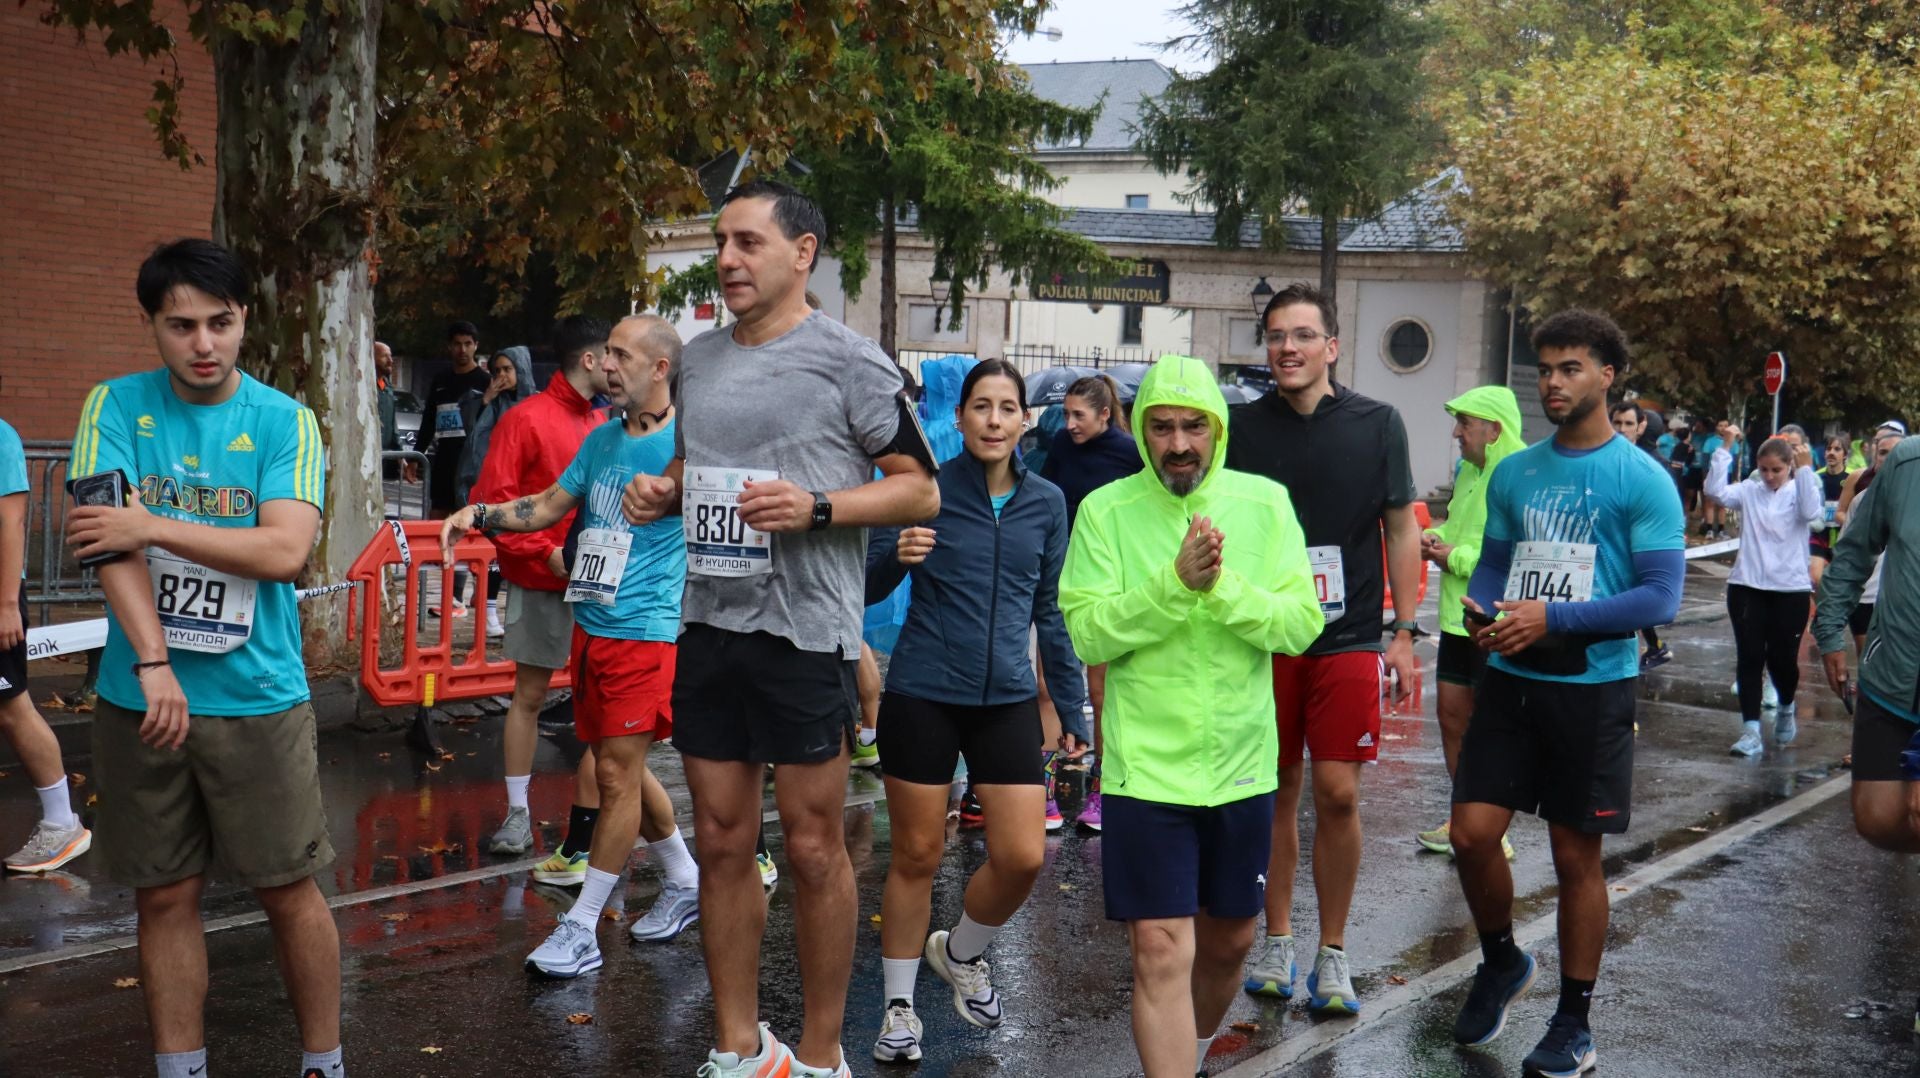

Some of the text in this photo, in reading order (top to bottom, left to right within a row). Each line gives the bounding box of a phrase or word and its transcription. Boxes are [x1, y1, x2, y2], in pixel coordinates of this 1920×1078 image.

[1092, 287, 1162, 303] MUNICIPAL
[1766, 368, 1781, 378] STOP
[139, 475, 256, 518] MADRID
[721, 494, 736, 504] LUI
[696, 504, 745, 544] 830
[183, 565, 207, 577] MANU
[578, 554, 607, 582] 701
[705, 558, 751, 569] HYUNDAI
[1518, 570, 1573, 603] 1044
[157, 573, 226, 620] 829
[169, 629, 228, 646] HYUNDAI
